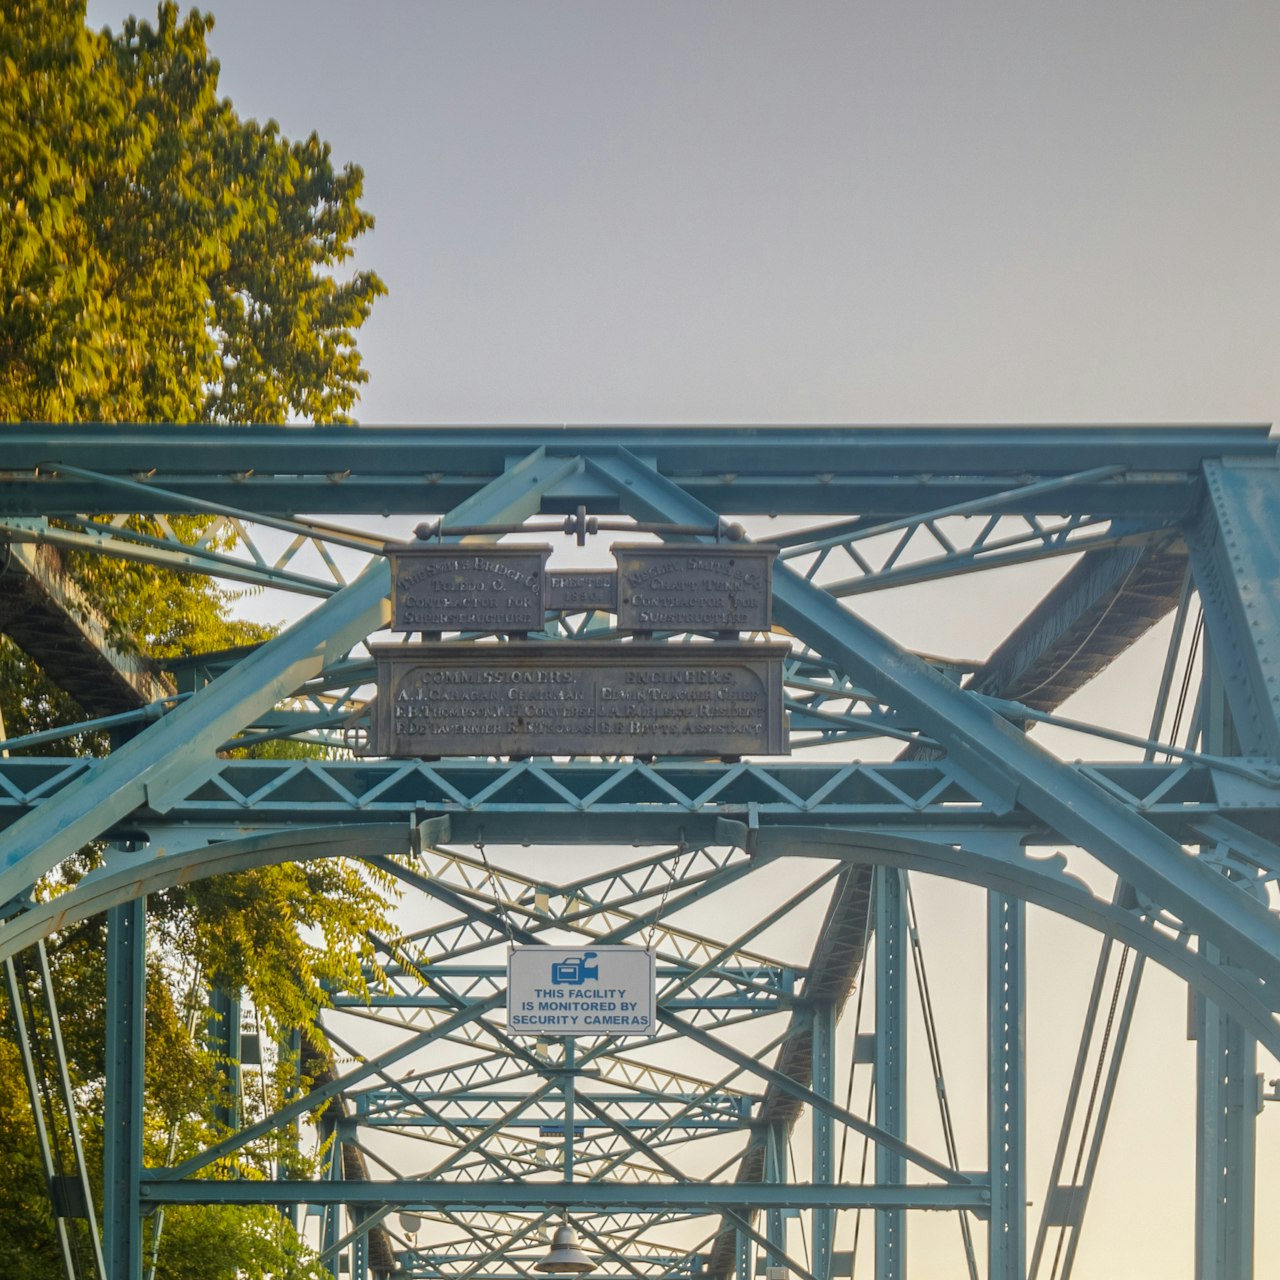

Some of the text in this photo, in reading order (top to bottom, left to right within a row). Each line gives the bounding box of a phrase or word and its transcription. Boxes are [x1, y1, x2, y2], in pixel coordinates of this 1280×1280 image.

[474, 556, 525, 581] BRIDGE
[551, 577, 611, 588] ERECTED
[406, 596, 532, 608] CONTRACTOR FOR
[632, 594, 759, 609] CONTRACTOR FOR
[404, 610, 532, 624] SUPERSTRUCTURE
[640, 609, 749, 624] SUBSTRUCTURE
[507, 687, 585, 701] CHAIRMAN
[601, 687, 646, 701] EDWIN
[716, 687, 758, 702] CHIEF
[524, 705, 595, 719] CONVERSE
[681, 721, 763, 736] ASSISTANT
[535, 989, 626, 998] THIS FACILITY
[522, 1002, 637, 1011] IS MONITORED BY
[513, 1015, 648, 1024] SECURITY CAMERAS
